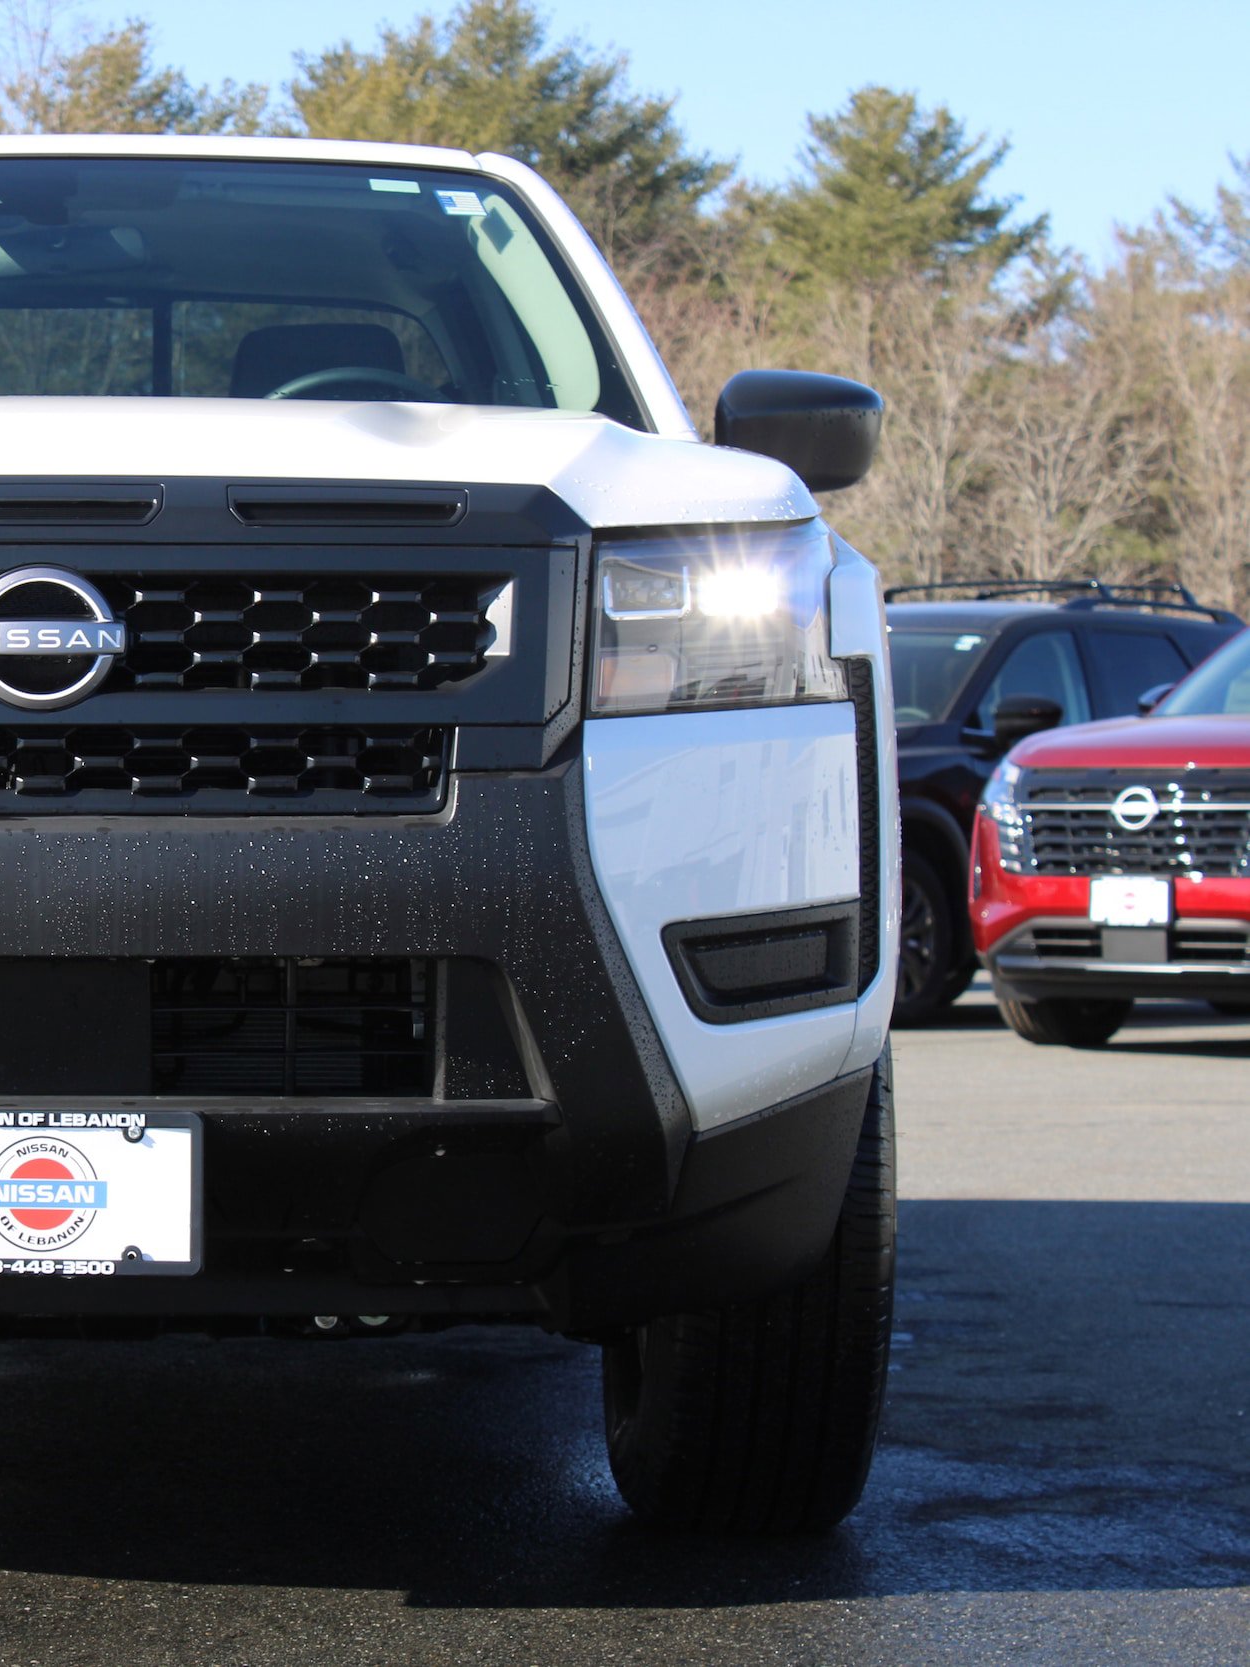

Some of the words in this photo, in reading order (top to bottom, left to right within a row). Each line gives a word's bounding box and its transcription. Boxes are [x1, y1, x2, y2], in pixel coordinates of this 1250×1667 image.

[18, 1112, 45, 1126] OF
[49, 1113, 146, 1127] LEBANON
[16, 1143, 69, 1158] NISSAN
[0, 1215, 17, 1232] OF
[18, 1215, 85, 1246] LEBANON
